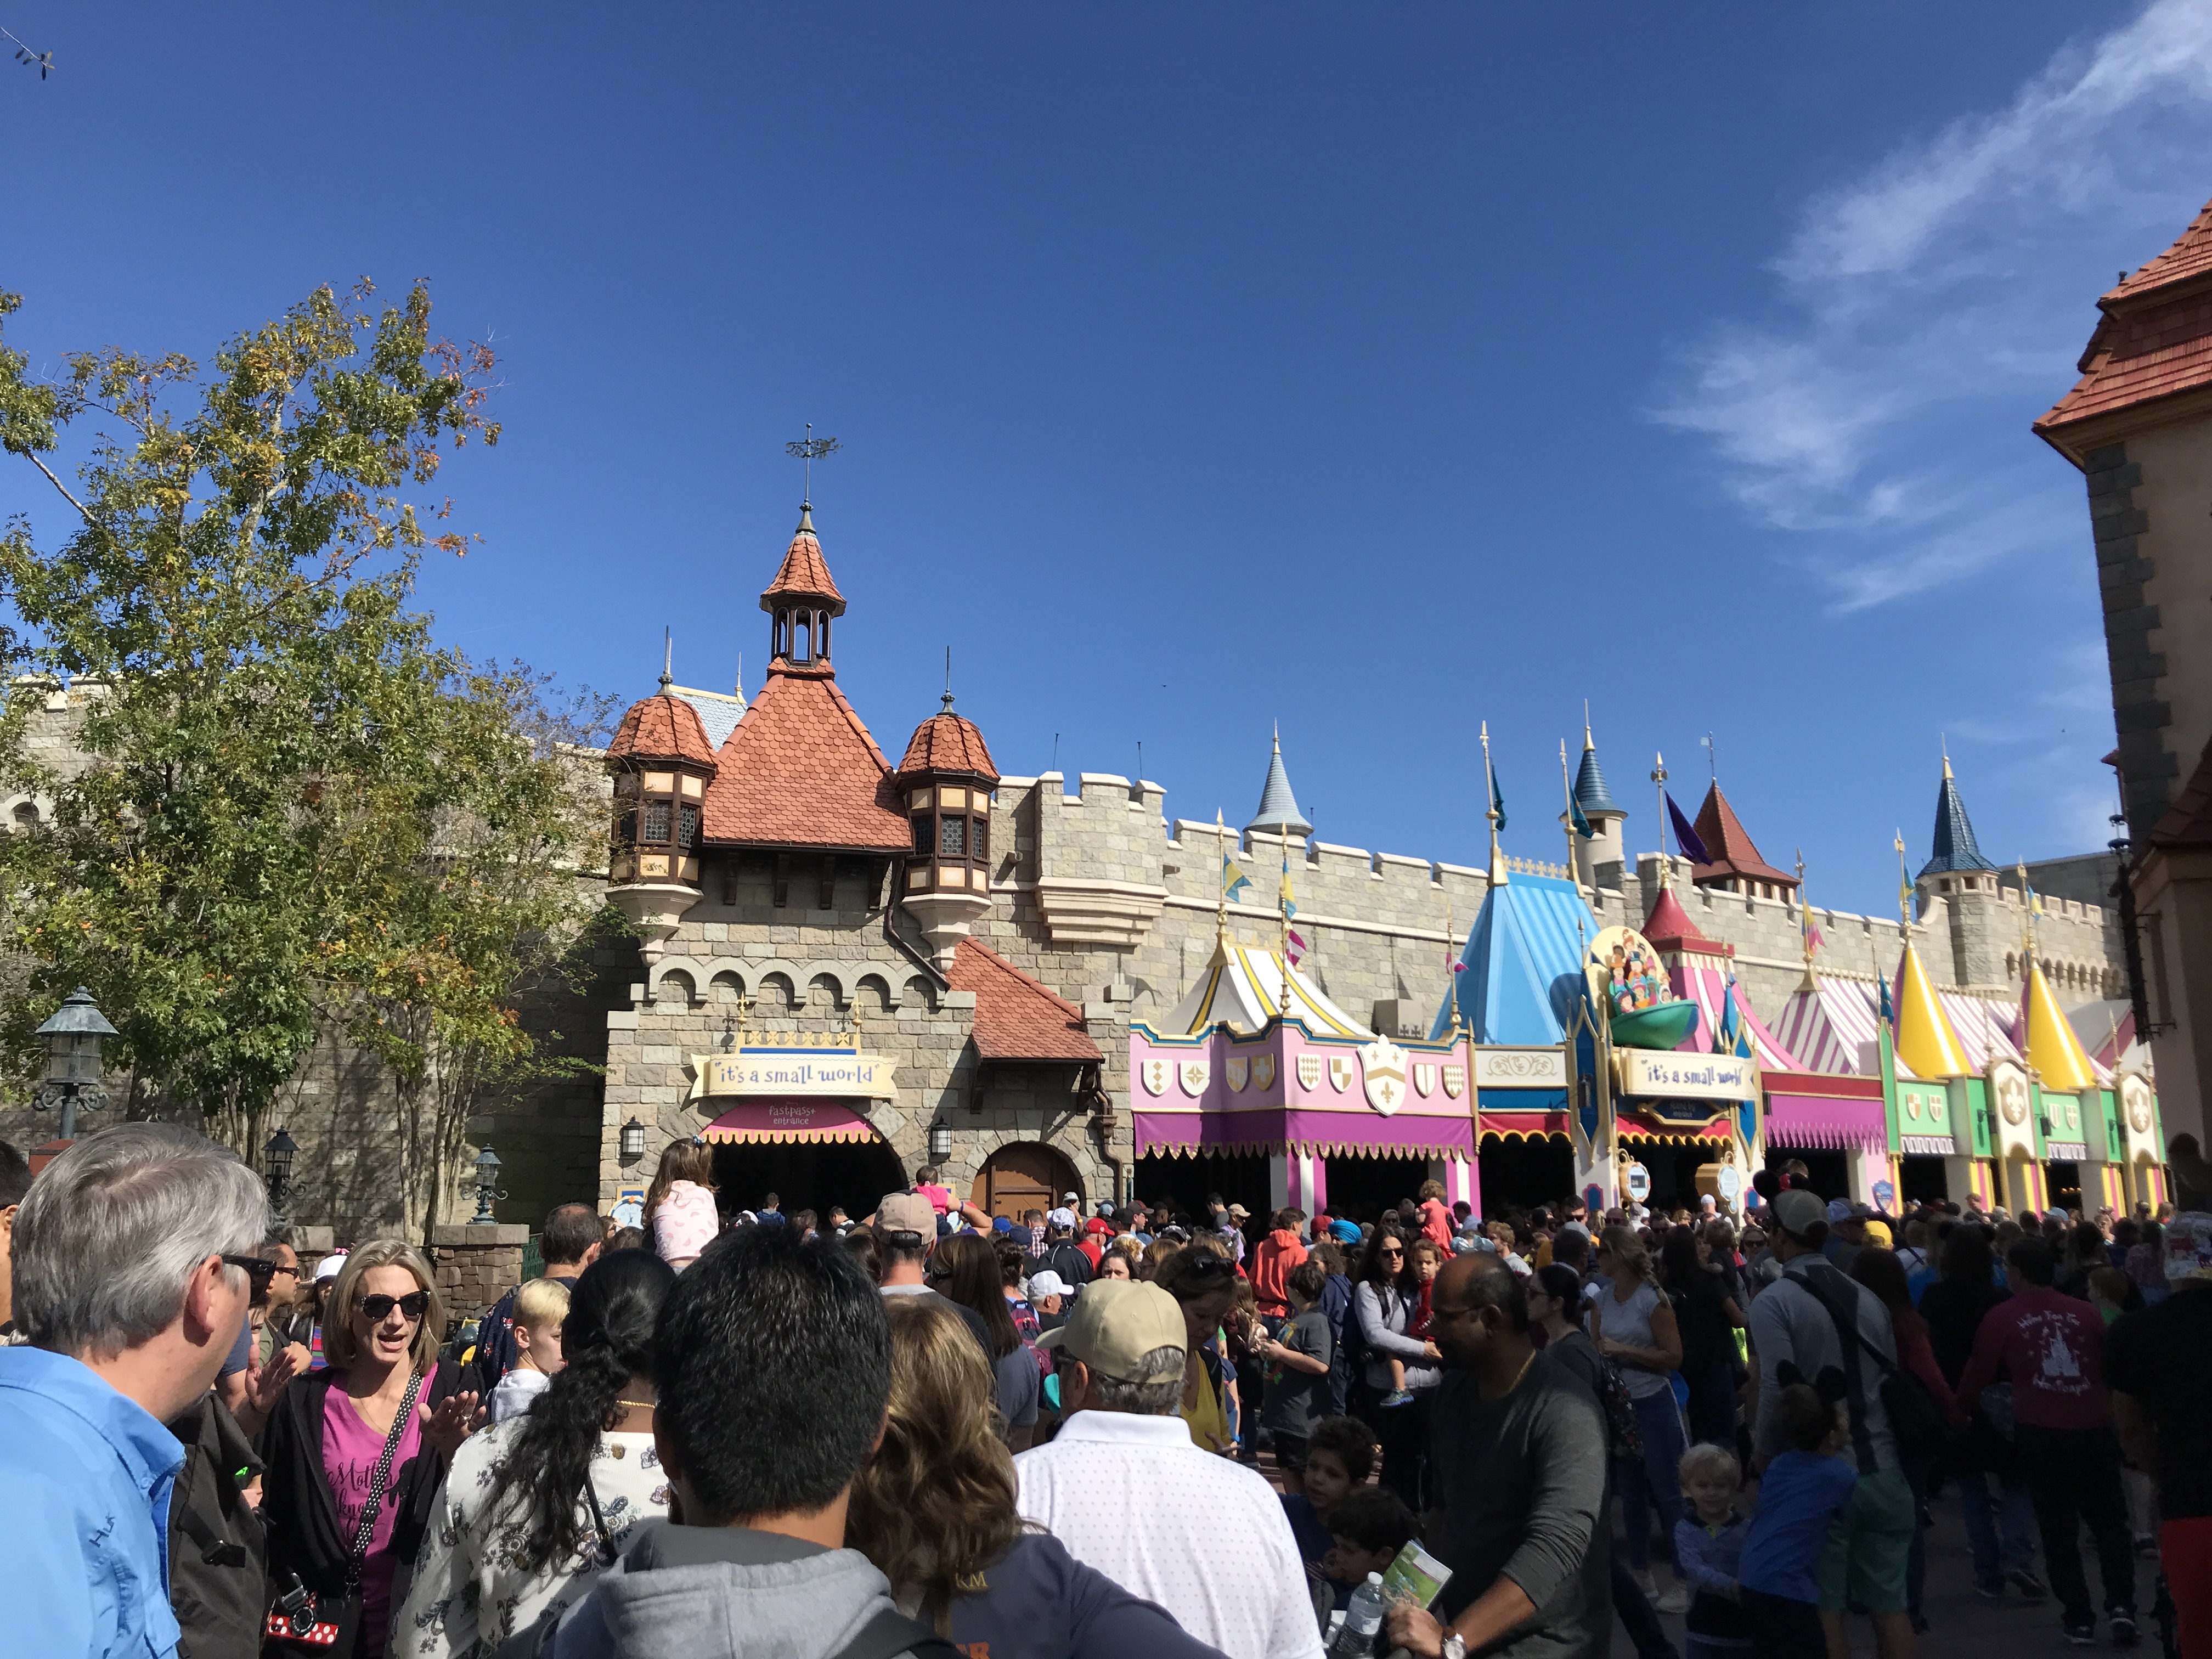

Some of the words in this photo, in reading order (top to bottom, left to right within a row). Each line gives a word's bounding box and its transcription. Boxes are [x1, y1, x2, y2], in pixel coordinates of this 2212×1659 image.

[749, 1068, 759, 1082] a
[765, 1064, 814, 1085] small
[1672, 1070, 1680, 1084] a
[1683, 1065, 1716, 1086] small
[773, 1117, 809, 1125] entrance
